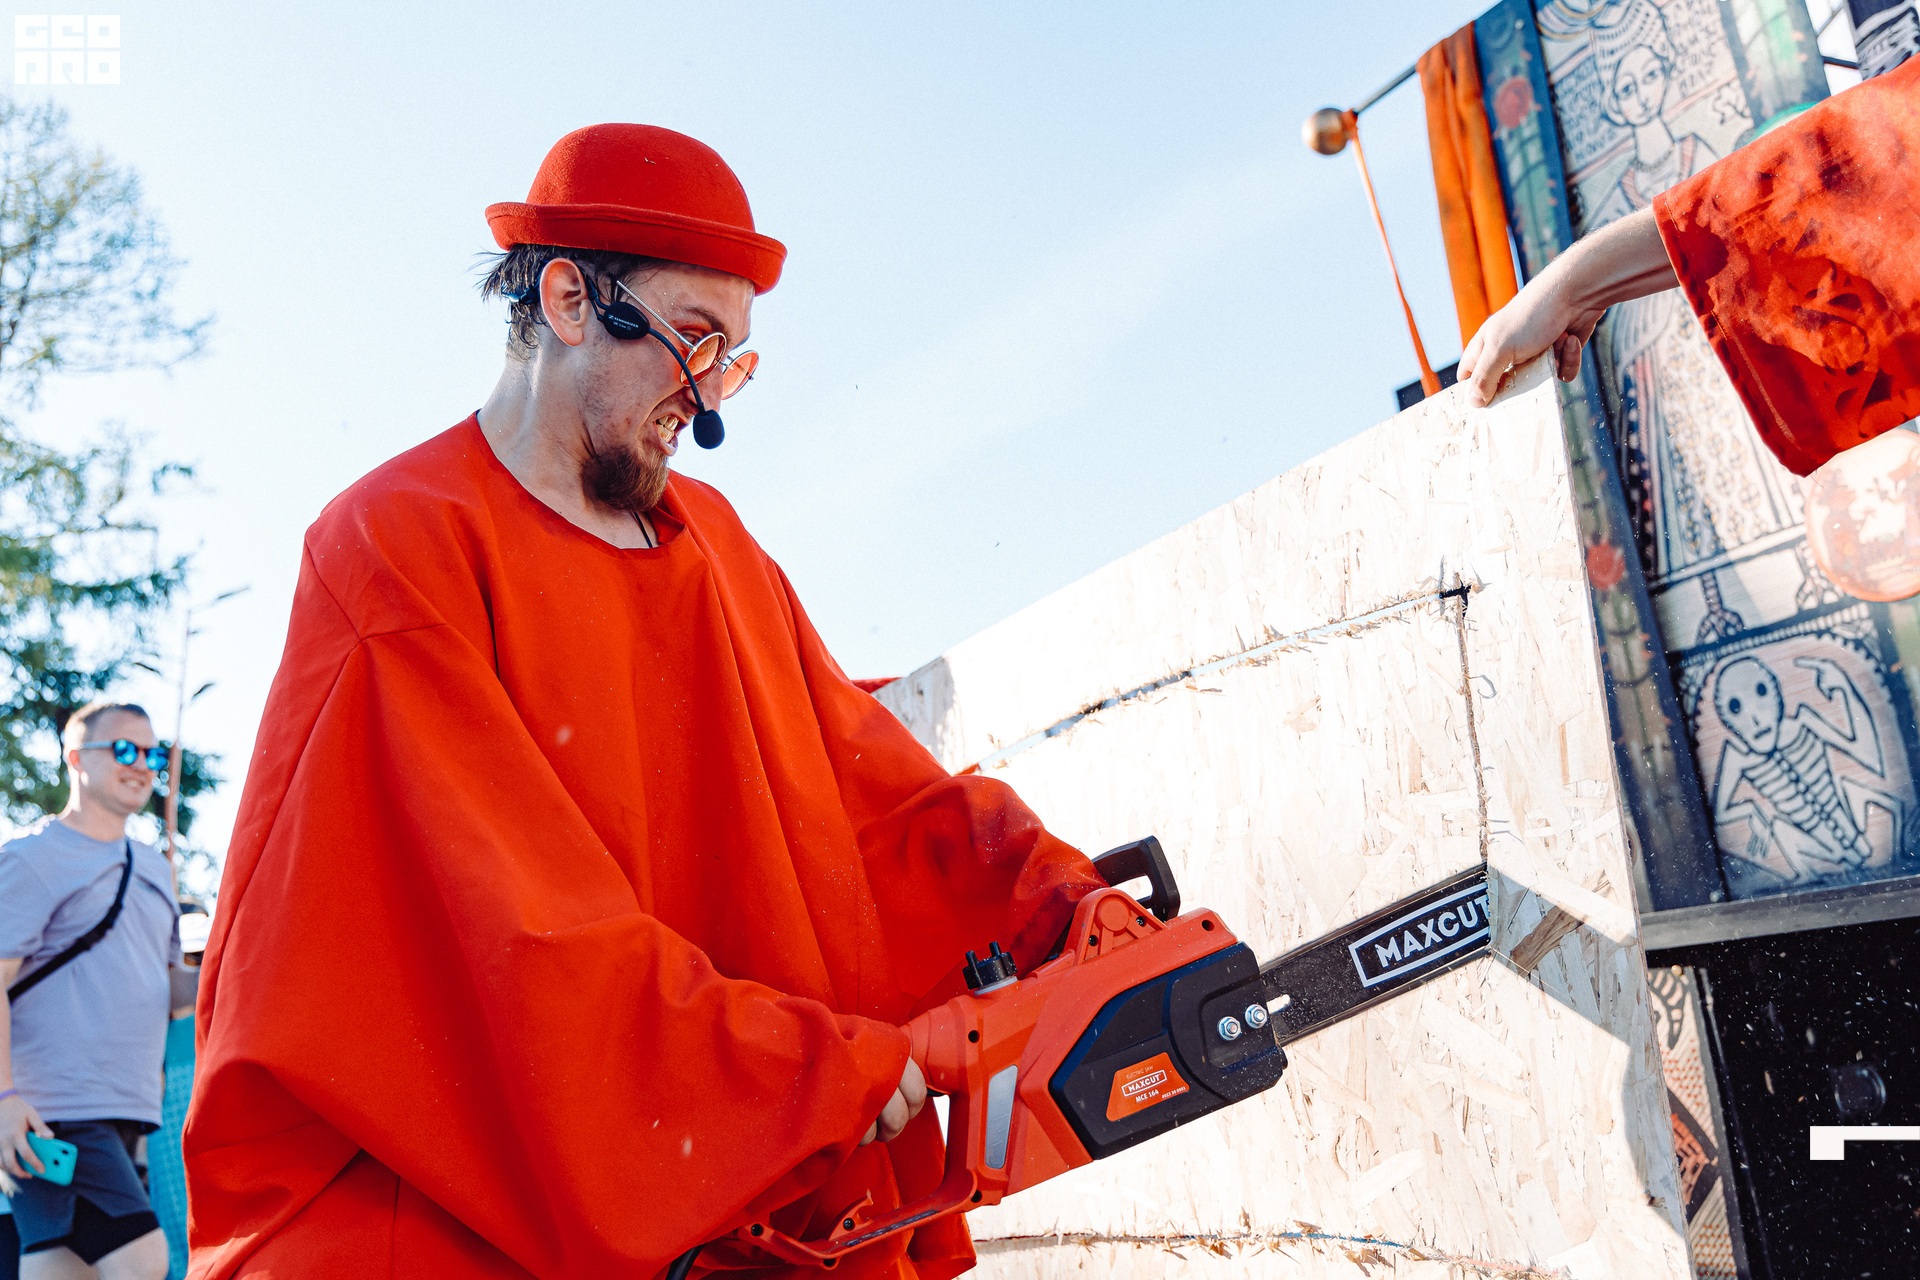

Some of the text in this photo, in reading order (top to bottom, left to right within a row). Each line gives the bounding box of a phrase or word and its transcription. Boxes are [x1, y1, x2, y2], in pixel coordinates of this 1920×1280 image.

[1374, 894, 1490, 968] MAXCUT
[1128, 1074, 1160, 1092] MAXCUT
[1135, 1089, 1159, 1103] MCE 164
